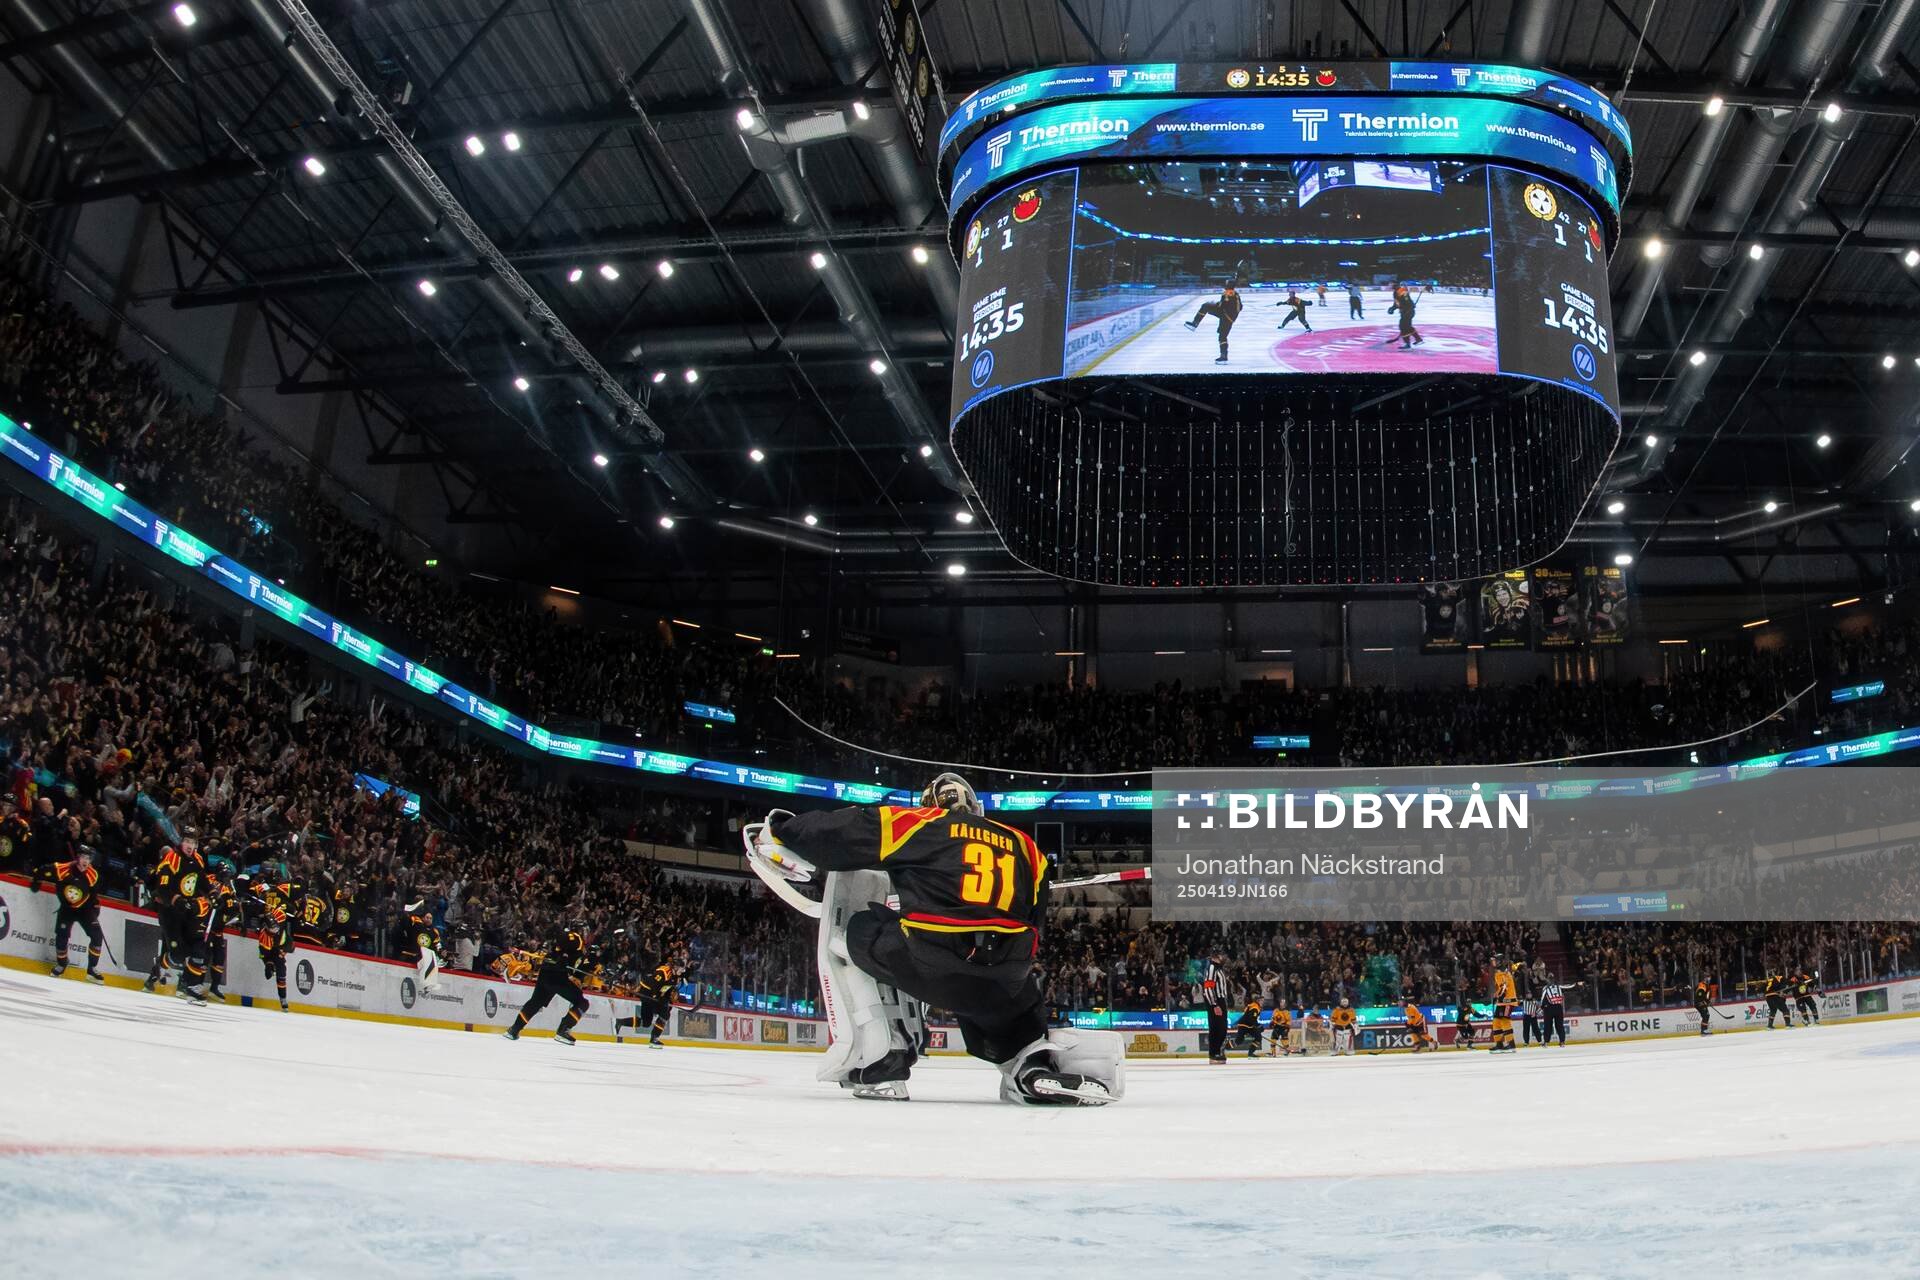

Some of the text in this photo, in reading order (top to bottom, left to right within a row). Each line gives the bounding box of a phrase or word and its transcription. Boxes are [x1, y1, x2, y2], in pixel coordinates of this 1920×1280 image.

[1132, 71, 1175, 82] Therm
[1255, 73, 1310, 87] 14:35
[1476, 71, 1537, 86] Thermion
[980, 83, 1028, 107] Thermion
[1156, 121, 1265, 132] www.thermion.se
[1338, 112, 1459, 130] Thermion
[1019, 117, 1129, 145] Thermion
[1486, 123, 1577, 154] www.thermion.se
[1558, 211, 1571, 225] 42
[975, 228, 1013, 268] 1 1
[1554, 224, 1593, 264] 1 1
[1560, 283, 1581, 298] GAME
[960, 302, 1024, 362] 14:35
[1544, 298, 1608, 354] 14:35
[64, 466, 105, 501] Thermion
[169, 531, 205, 561] Thermion
[262, 586, 293, 611] Thermion
[343, 631, 371, 651] Thermion
[1841, 740, 1880, 754] Thermion
[649, 755, 687, 769] Thermion
[1741, 760, 1778, 773] Thermion
[751, 772, 787, 785] Thermion
[848, 786, 883, 798] Thermion
[1552, 784, 1592, 793] Thermion
[1007, 794, 1046, 805] Thermion
[961, 843, 1016, 912] 31
[11, 930, 47, 945] FACILITY
[1594, 1018, 1661, 1033] THORNE
[1363, 1030, 1415, 1048] Brixo
